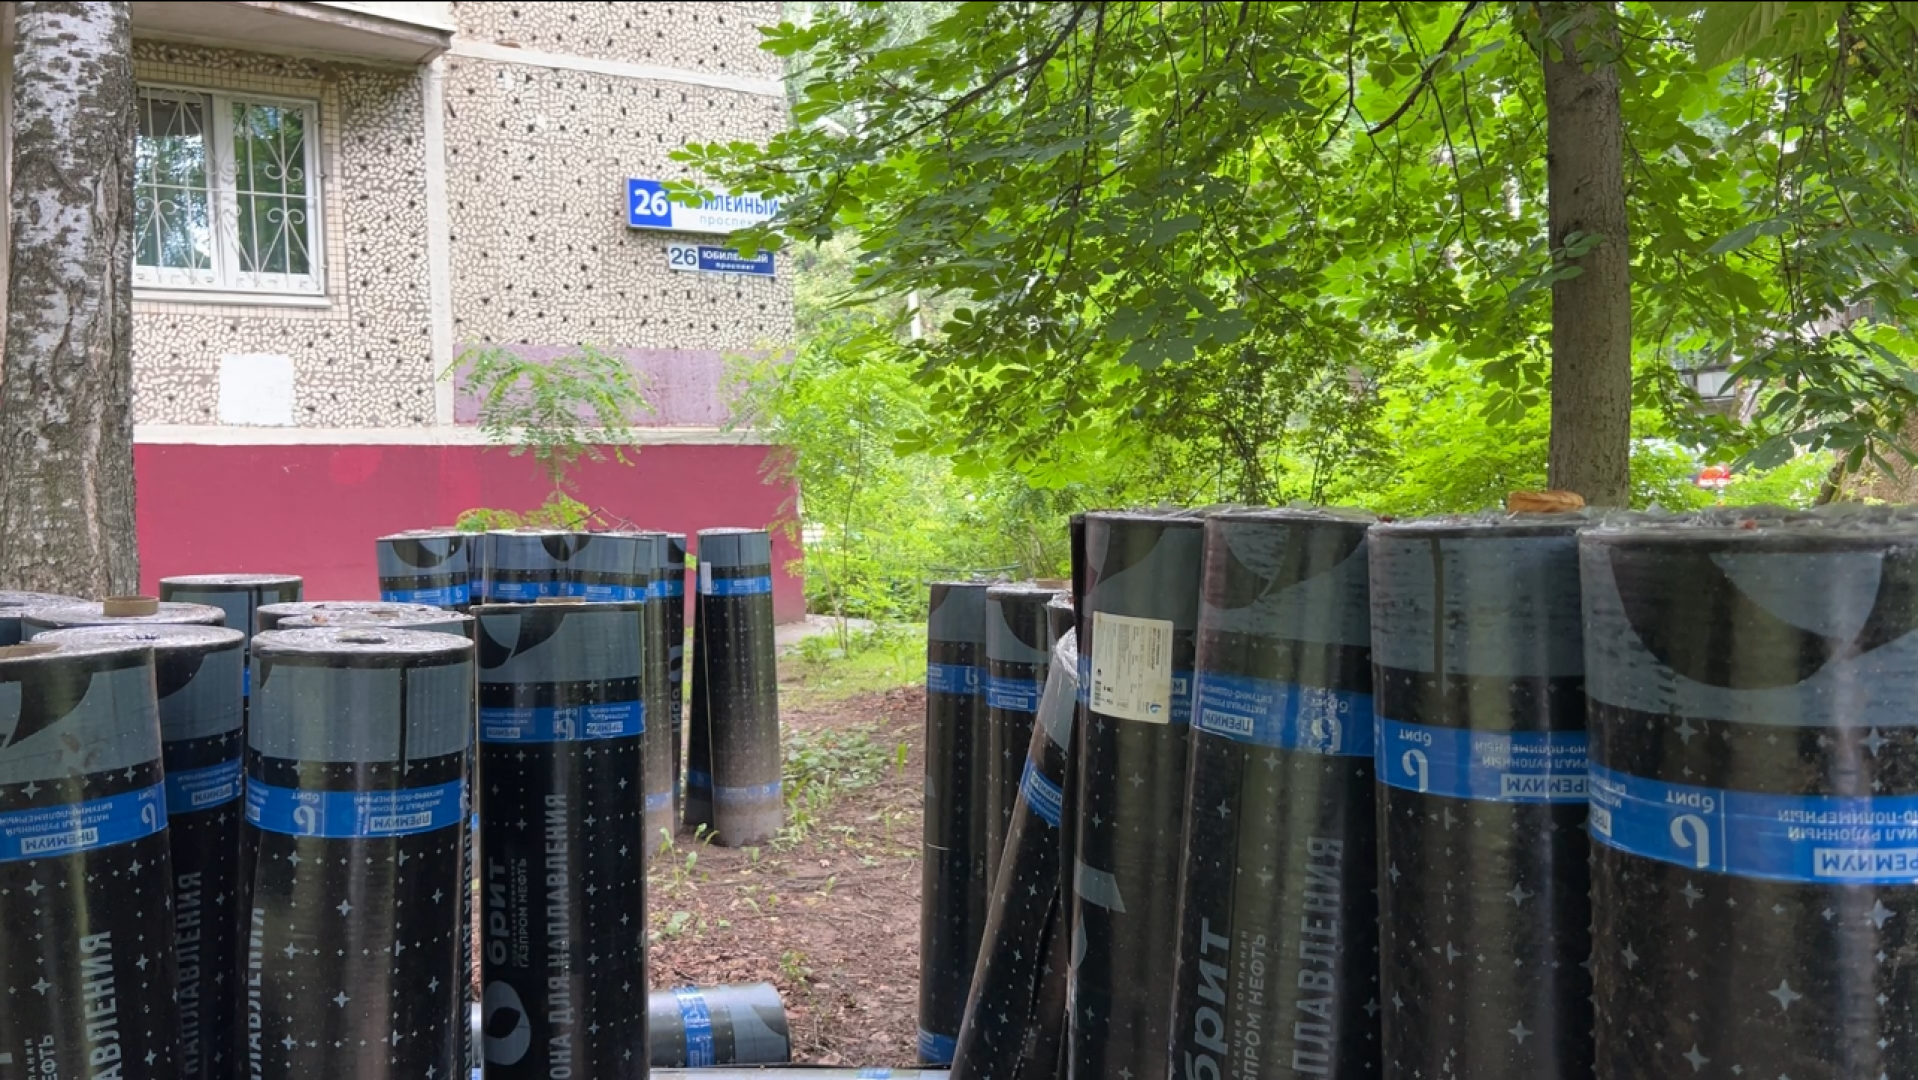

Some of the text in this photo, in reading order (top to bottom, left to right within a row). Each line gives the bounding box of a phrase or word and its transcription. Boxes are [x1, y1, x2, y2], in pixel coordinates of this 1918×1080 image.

[634, 189, 669, 217] 26
[671, 247, 697, 266] 26
[1398, 728, 1432, 747] брит
[1475, 740, 1586, 758] НО-ПОЛИМЕРНЫЙ
[1481, 755, 1552, 770] РУЛОННЫЙ
[291, 791, 321, 804] брит
[1664, 789, 1715, 814] брит
[5, 821, 60, 837] РУЛОННЫЙ
[374, 813, 430, 829] ПРЕМИУМ
[1787, 825, 1881, 842] РУЛОННЫЙ
[25, 830, 96, 851] ПРЕМИУМ
[487, 856, 510, 966] брит
[517, 858, 529, 968] ГАЗПРОМ НЕФТЬ
[544, 793, 575, 1079] ОНА ДЛЯ НАПЛАВЛЕНИЯ
[1291, 835, 1344, 1076] ПЛАВЛЕНИЯ
[79, 931, 124, 1080] АВЛЕНИЯ
[1231, 929, 1248, 1078] ДУКЦИЯ КОМПАНИИ
[1241, 933, 1266, 1080] ЗПРОМ НЕФТЬ
[38, 1035, 58, 1080] ЕФТЬ
